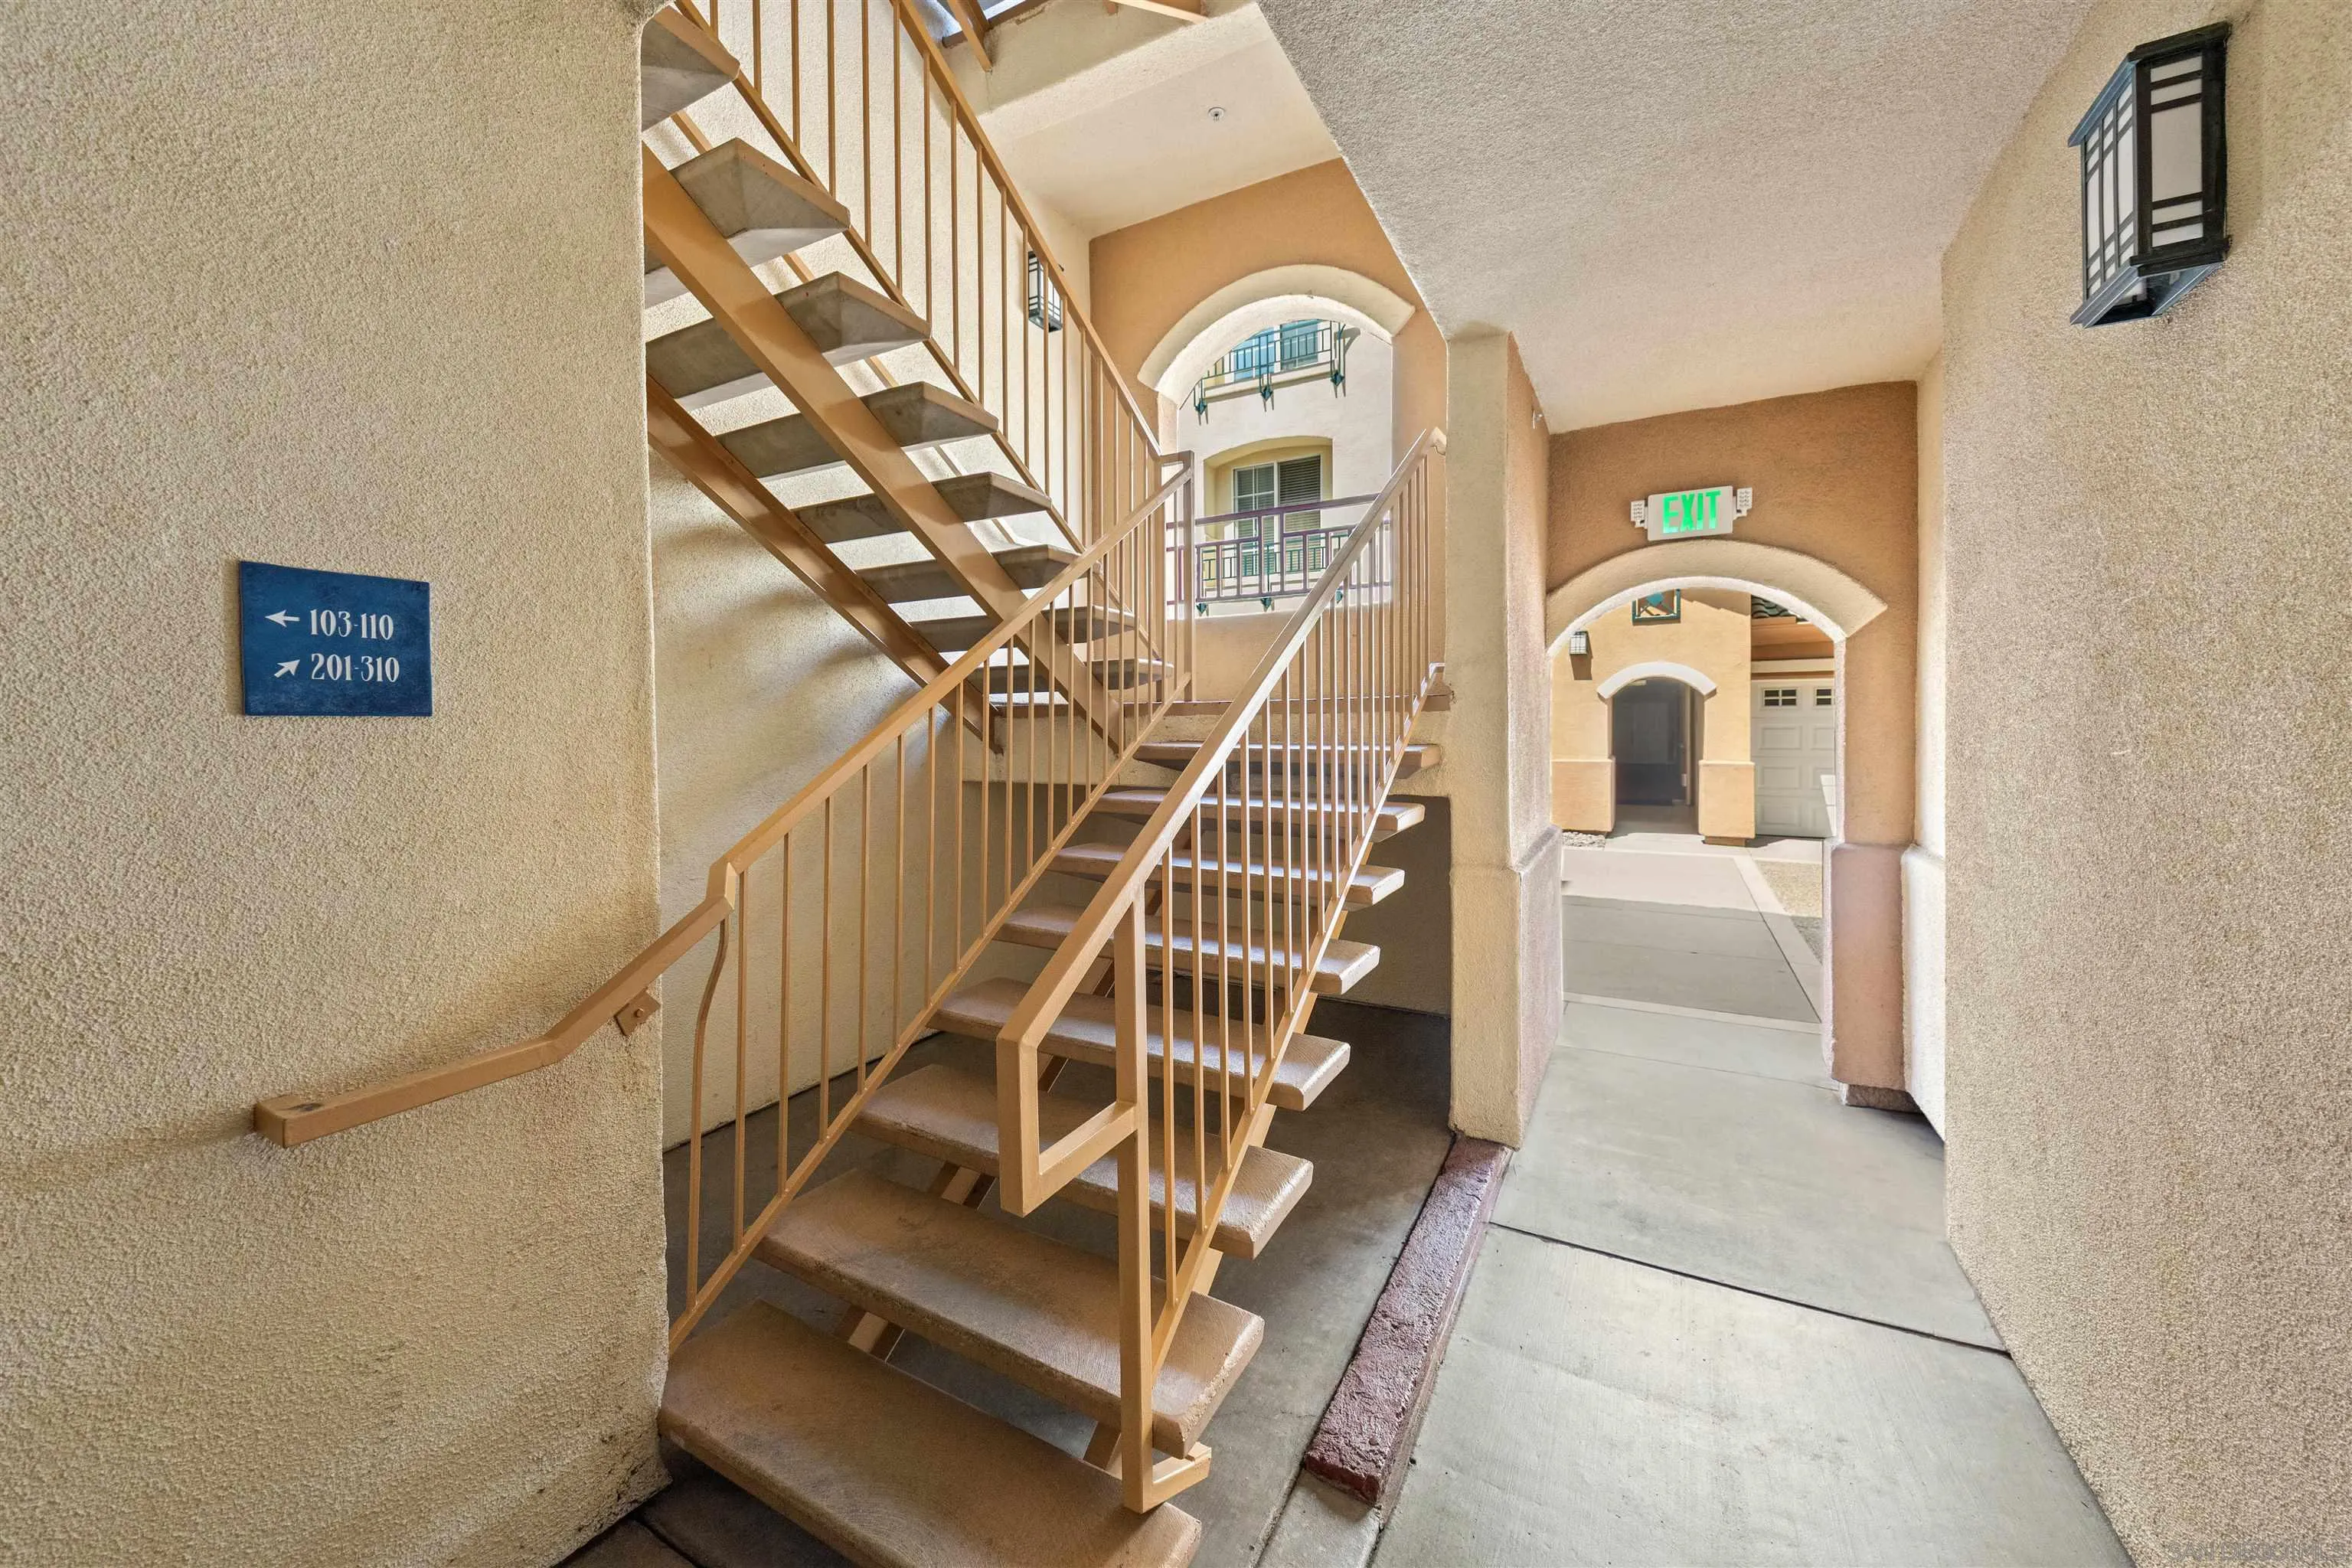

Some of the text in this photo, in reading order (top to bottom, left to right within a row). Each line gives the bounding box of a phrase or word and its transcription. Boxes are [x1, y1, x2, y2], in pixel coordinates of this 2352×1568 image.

[1663, 491, 1720, 533] EXIT
[309, 609, 394, 640] 103-110
[311, 653, 400, 682] 201-310
